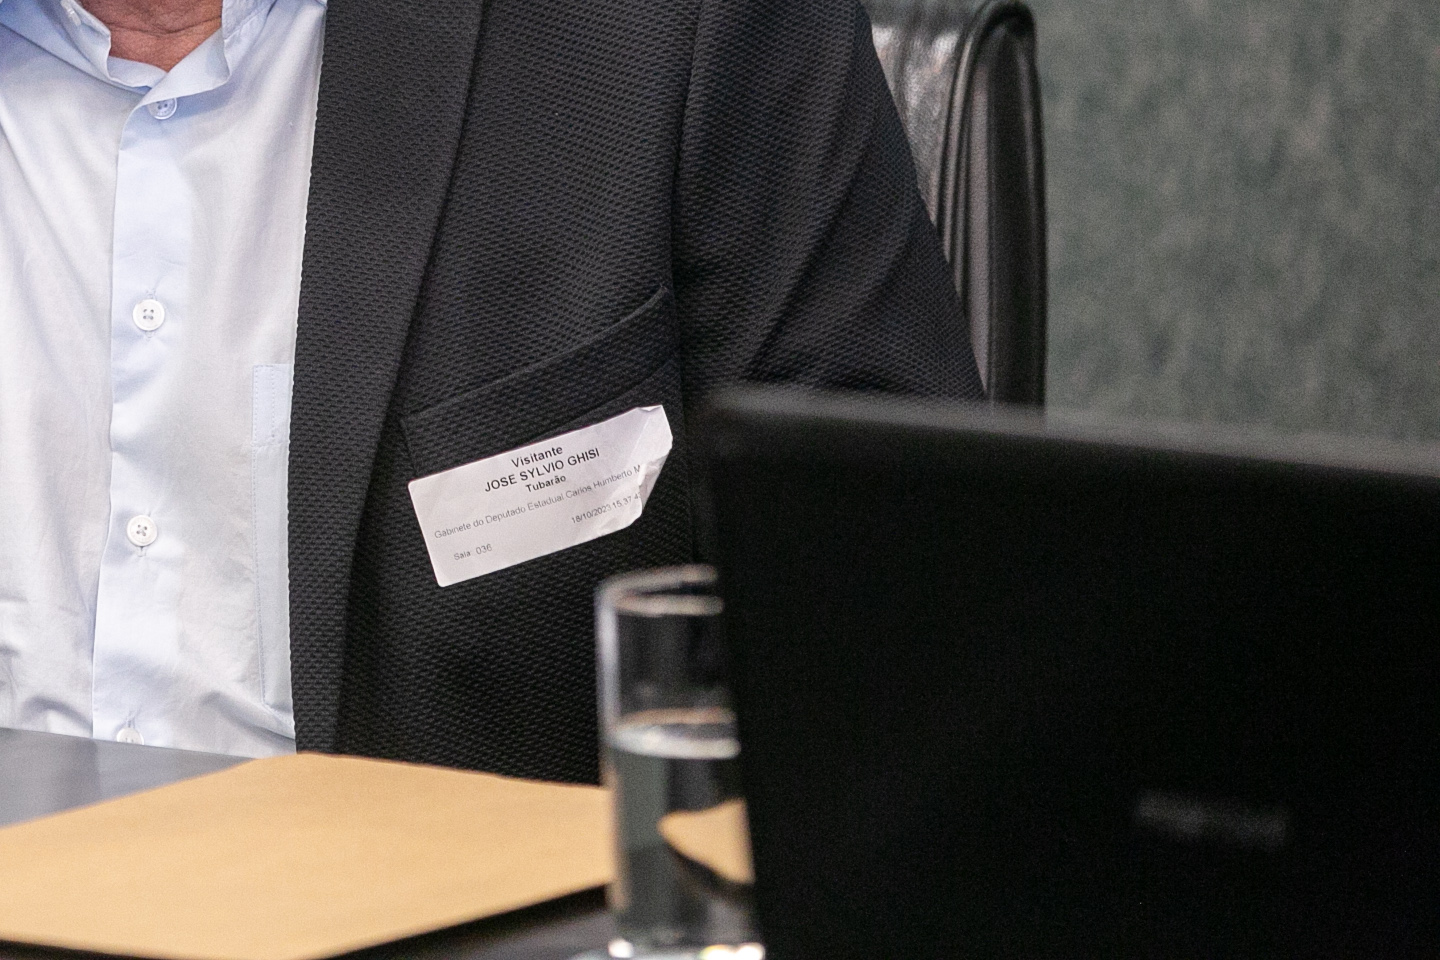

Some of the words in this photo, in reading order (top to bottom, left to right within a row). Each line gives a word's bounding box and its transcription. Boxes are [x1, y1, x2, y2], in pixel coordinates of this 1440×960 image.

[511, 445, 564, 468] Visitante
[484, 474, 518, 493] JOSE
[519, 460, 565, 482] SYLVIO
[567, 447, 600, 467] GHISI
[525, 474, 567, 493] Tubarão
[434, 522, 472, 539] Gabinete
[473, 518, 484, 528] do
[485, 505, 527, 524] Deputado
[527, 494, 565, 512] Estadual
[566, 484, 593, 499] Carlos
[593, 469, 633, 489] Humberto
[571, 503, 612, 524] 18/10/2023
[476, 543, 493, 556] 036
